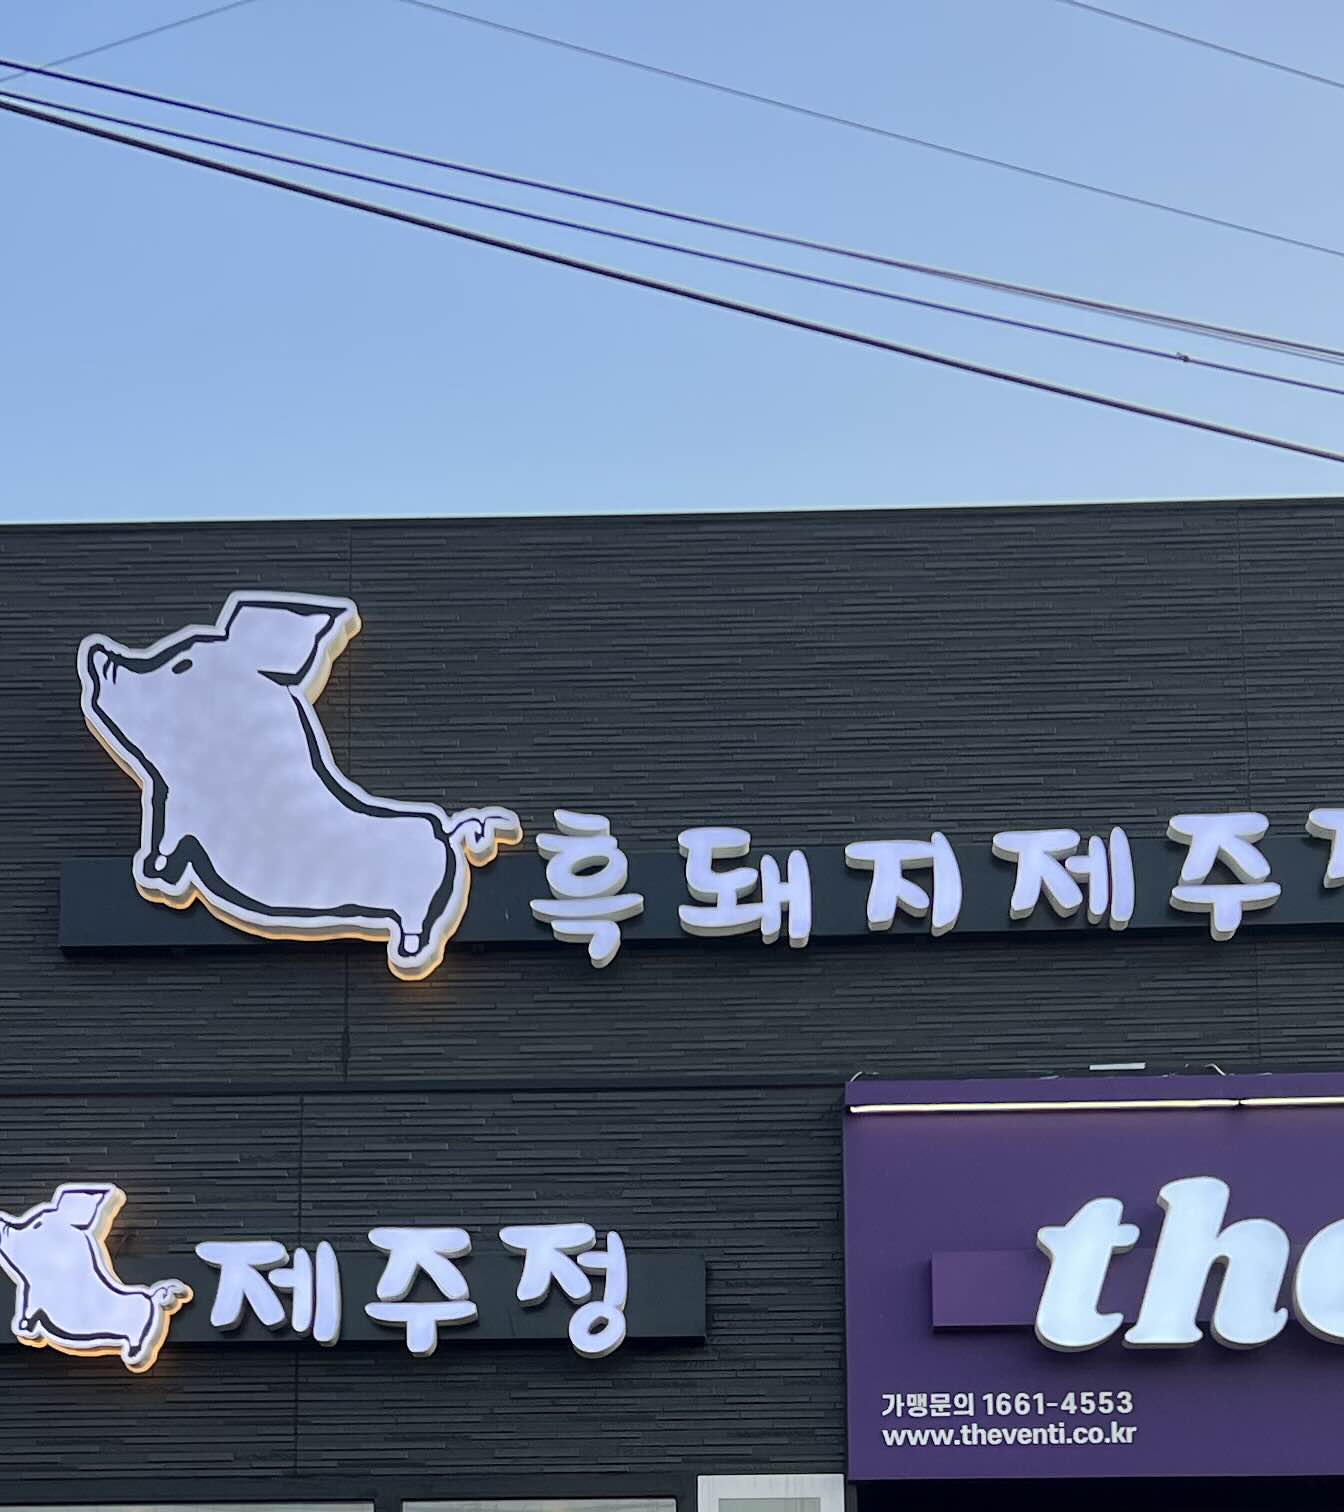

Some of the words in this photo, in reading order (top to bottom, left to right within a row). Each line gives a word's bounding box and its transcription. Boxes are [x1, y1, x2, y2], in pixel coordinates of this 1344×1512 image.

[194, 1221, 630, 1360] 제주정
[881, 1392, 975, 1418] 가맹문의
[981, 1391, 1134, 1416] 1661-4553
[881, 1421, 1137, 1446] www.theventi.co.kr
